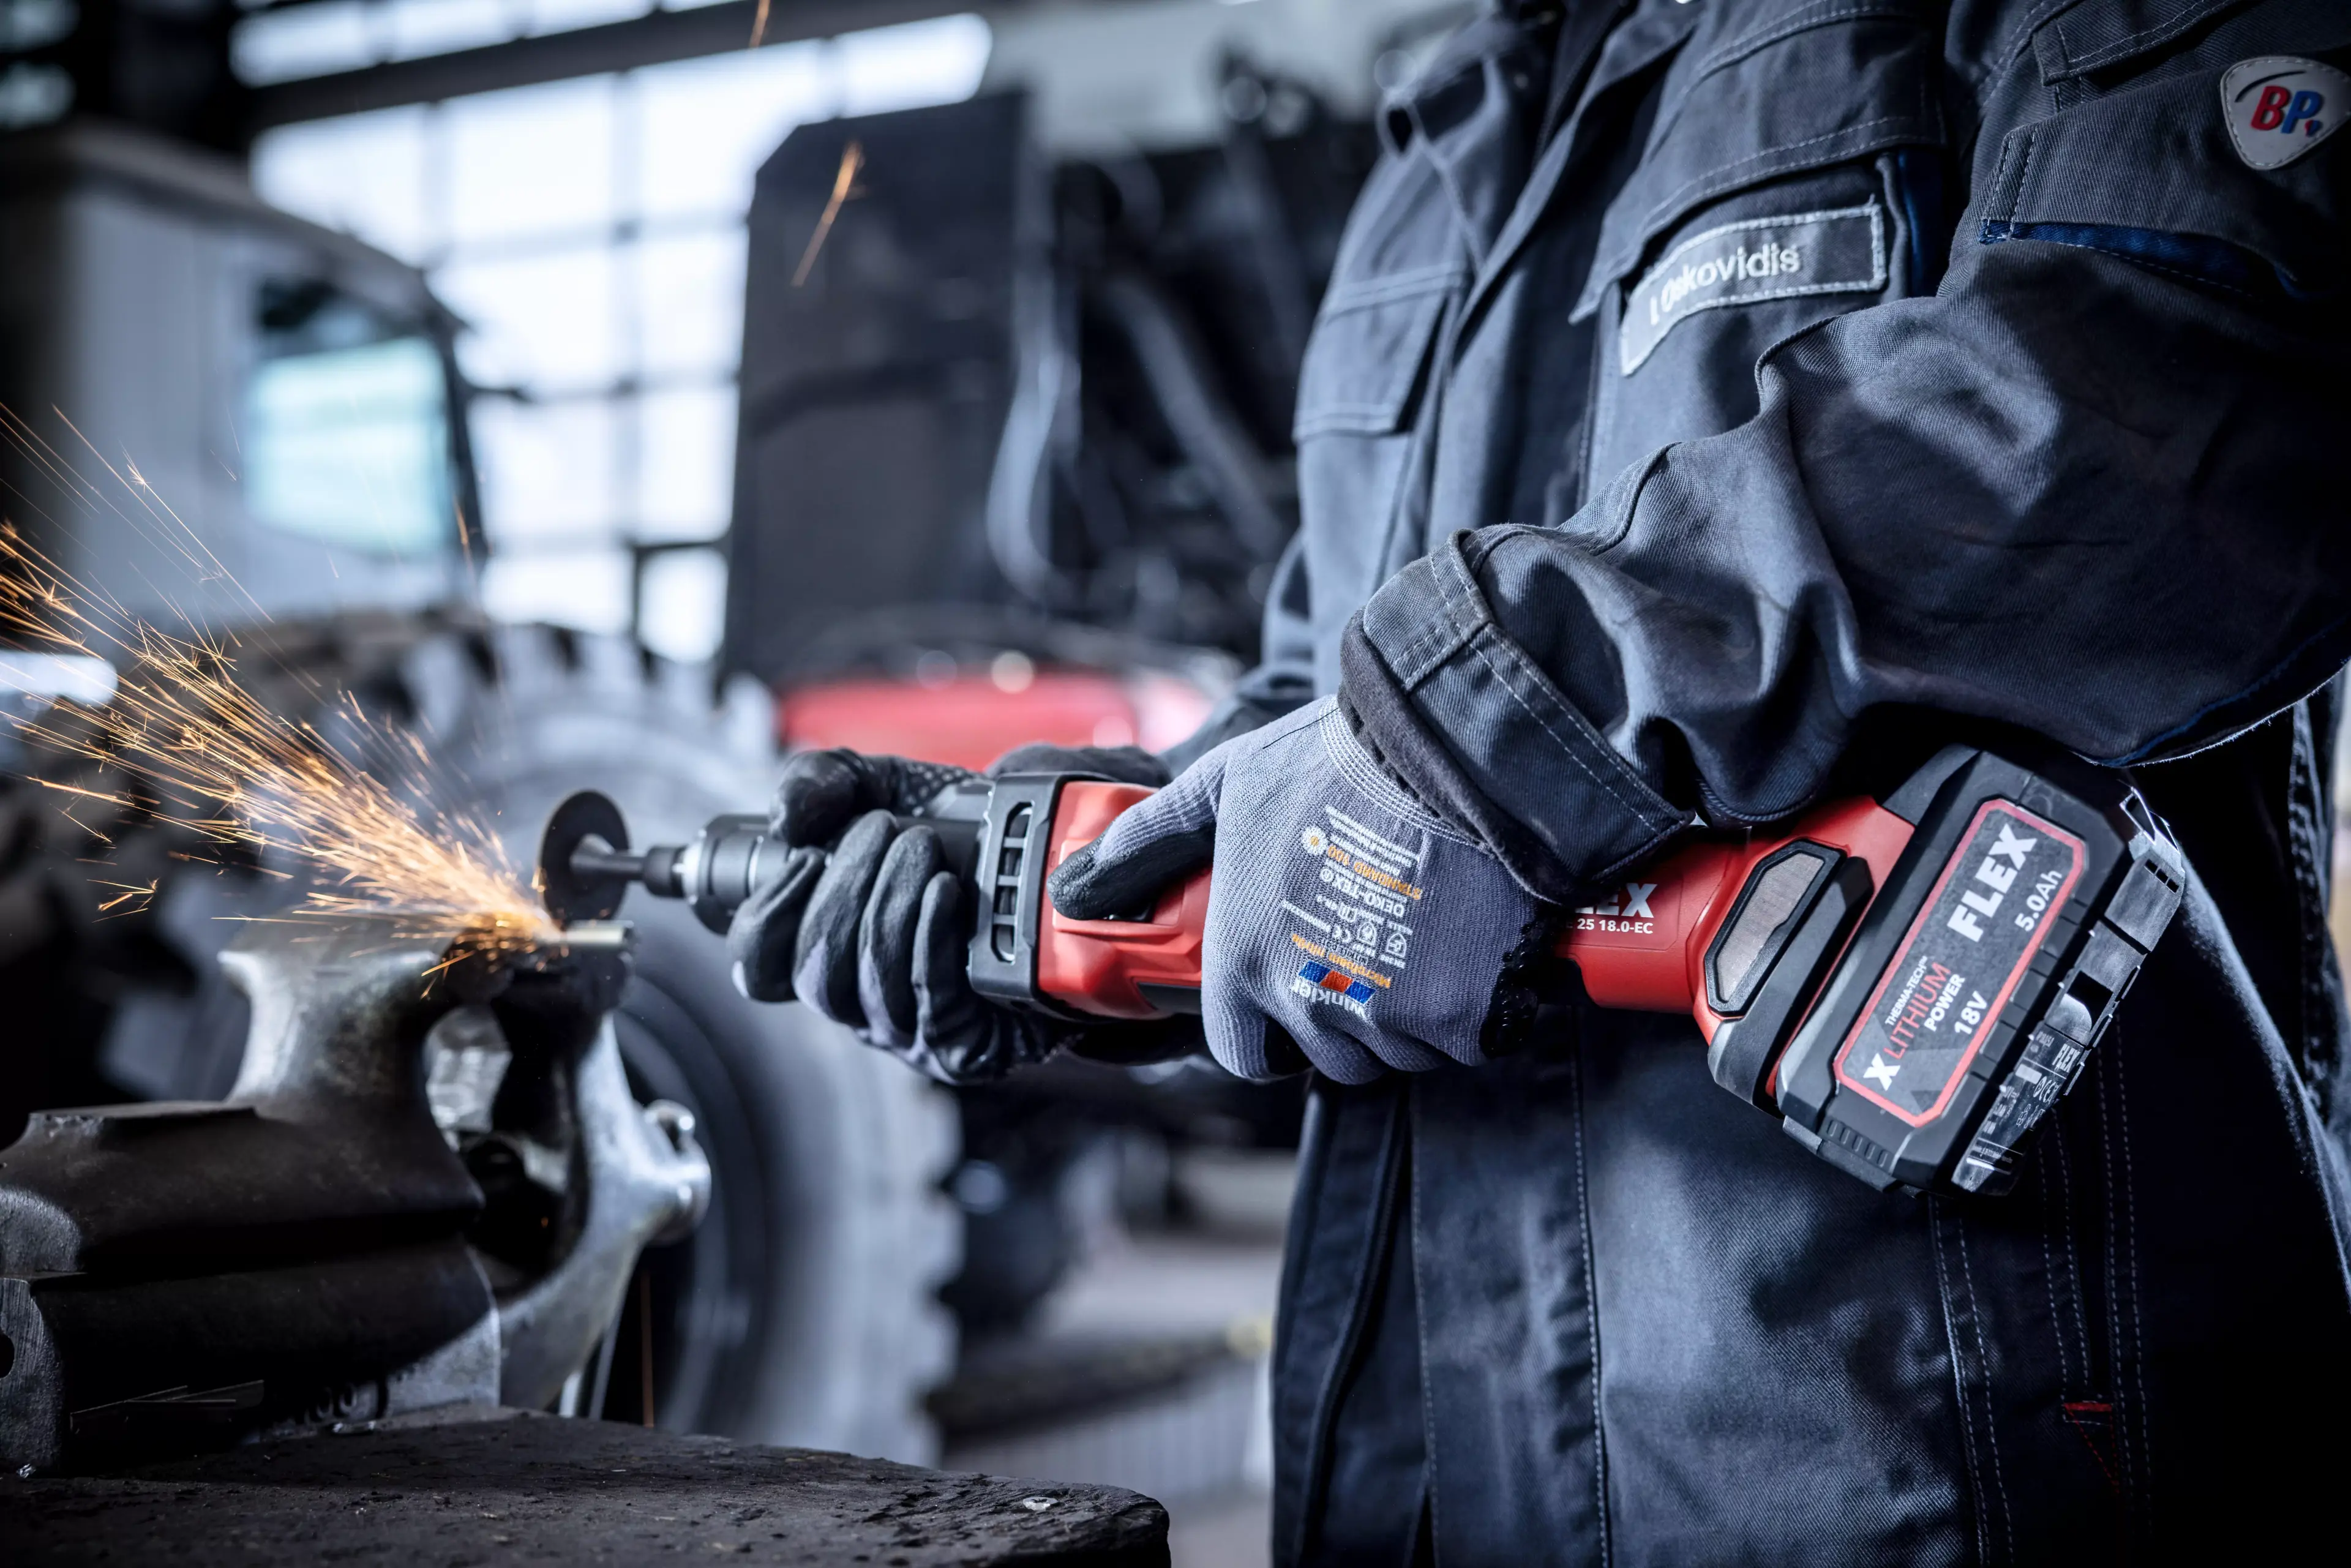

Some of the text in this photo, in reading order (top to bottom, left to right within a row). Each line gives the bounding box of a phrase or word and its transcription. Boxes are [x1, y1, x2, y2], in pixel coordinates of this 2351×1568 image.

[1948, 823, 2038, 942] FLEX
[2015, 869, 2062, 931] 5.0Ah
[1577, 918, 1594, 930] 25
[1599, 919, 1653, 934] 18.0-EC
[1393, 958, 1405, 969] EN
[1291, 977, 1363, 1016] winkler
[1924, 973, 1965, 1032] POWER
[1954, 990, 1987, 1035] 18V
[1862, 962, 1952, 1091] X LITHIUM
[2052, 1043, 2081, 1073] FLEX
